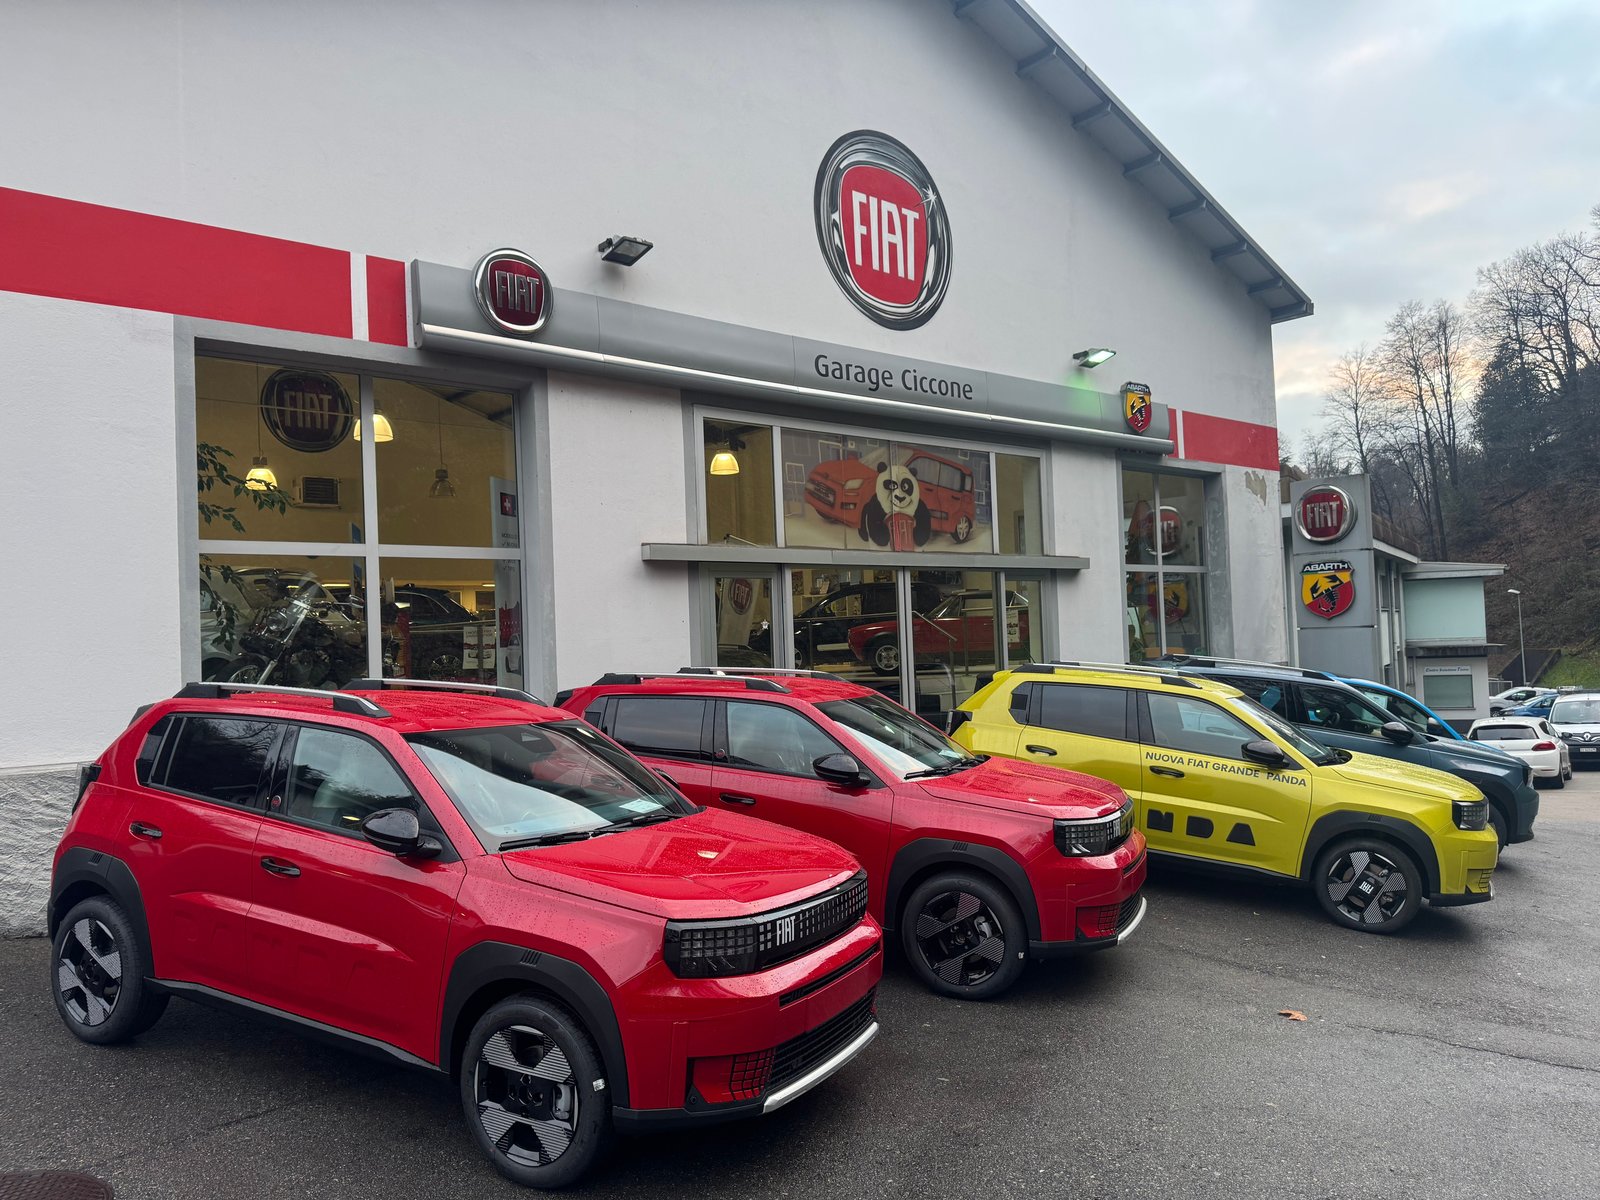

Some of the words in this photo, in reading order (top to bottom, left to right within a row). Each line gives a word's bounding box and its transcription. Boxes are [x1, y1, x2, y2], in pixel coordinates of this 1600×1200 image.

[852, 190, 920, 281] FIAT
[495, 270, 540, 314] FIAT
[814, 354, 894, 392] Garage
[901, 369, 973, 400] Ciccone
[1126, 383, 1149, 393] ABARTH
[283, 391, 333, 430] FIAT
[1306, 501, 1340, 529] FIAT
[1303, 562, 1348, 572] ABARTH
[1145, 751, 1185, 766] NUOVA
[1187, 758, 1210, 769] FIAT
[1212, 762, 1260, 779] GRANDE
[1266, 772, 1307, 788] PANDA
[1359, 881, 1374, 895] FIAT
[776, 915, 796, 946] FIAT
